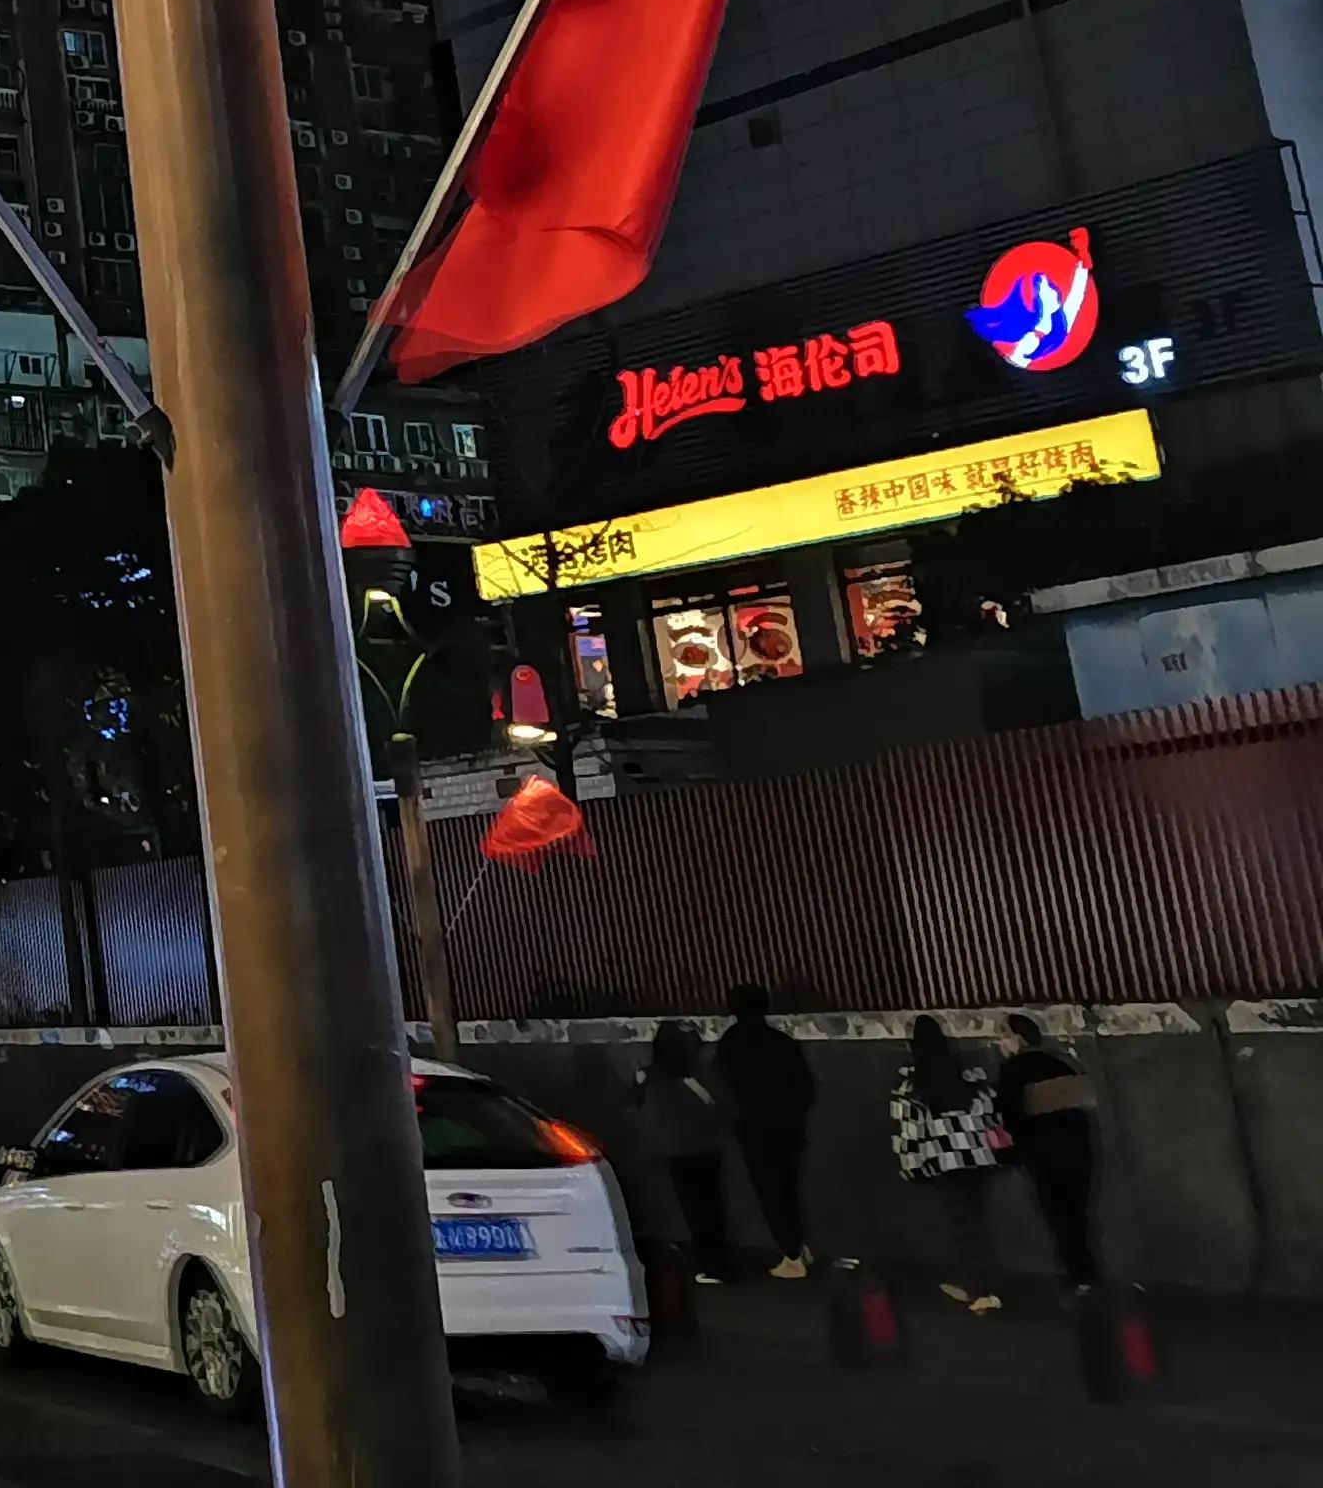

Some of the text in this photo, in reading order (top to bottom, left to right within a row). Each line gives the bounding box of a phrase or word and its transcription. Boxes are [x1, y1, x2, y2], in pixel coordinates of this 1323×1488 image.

[608, 320, 901, 449] Helen's 海伦司
[1118, 338, 1175, 385] 3F
